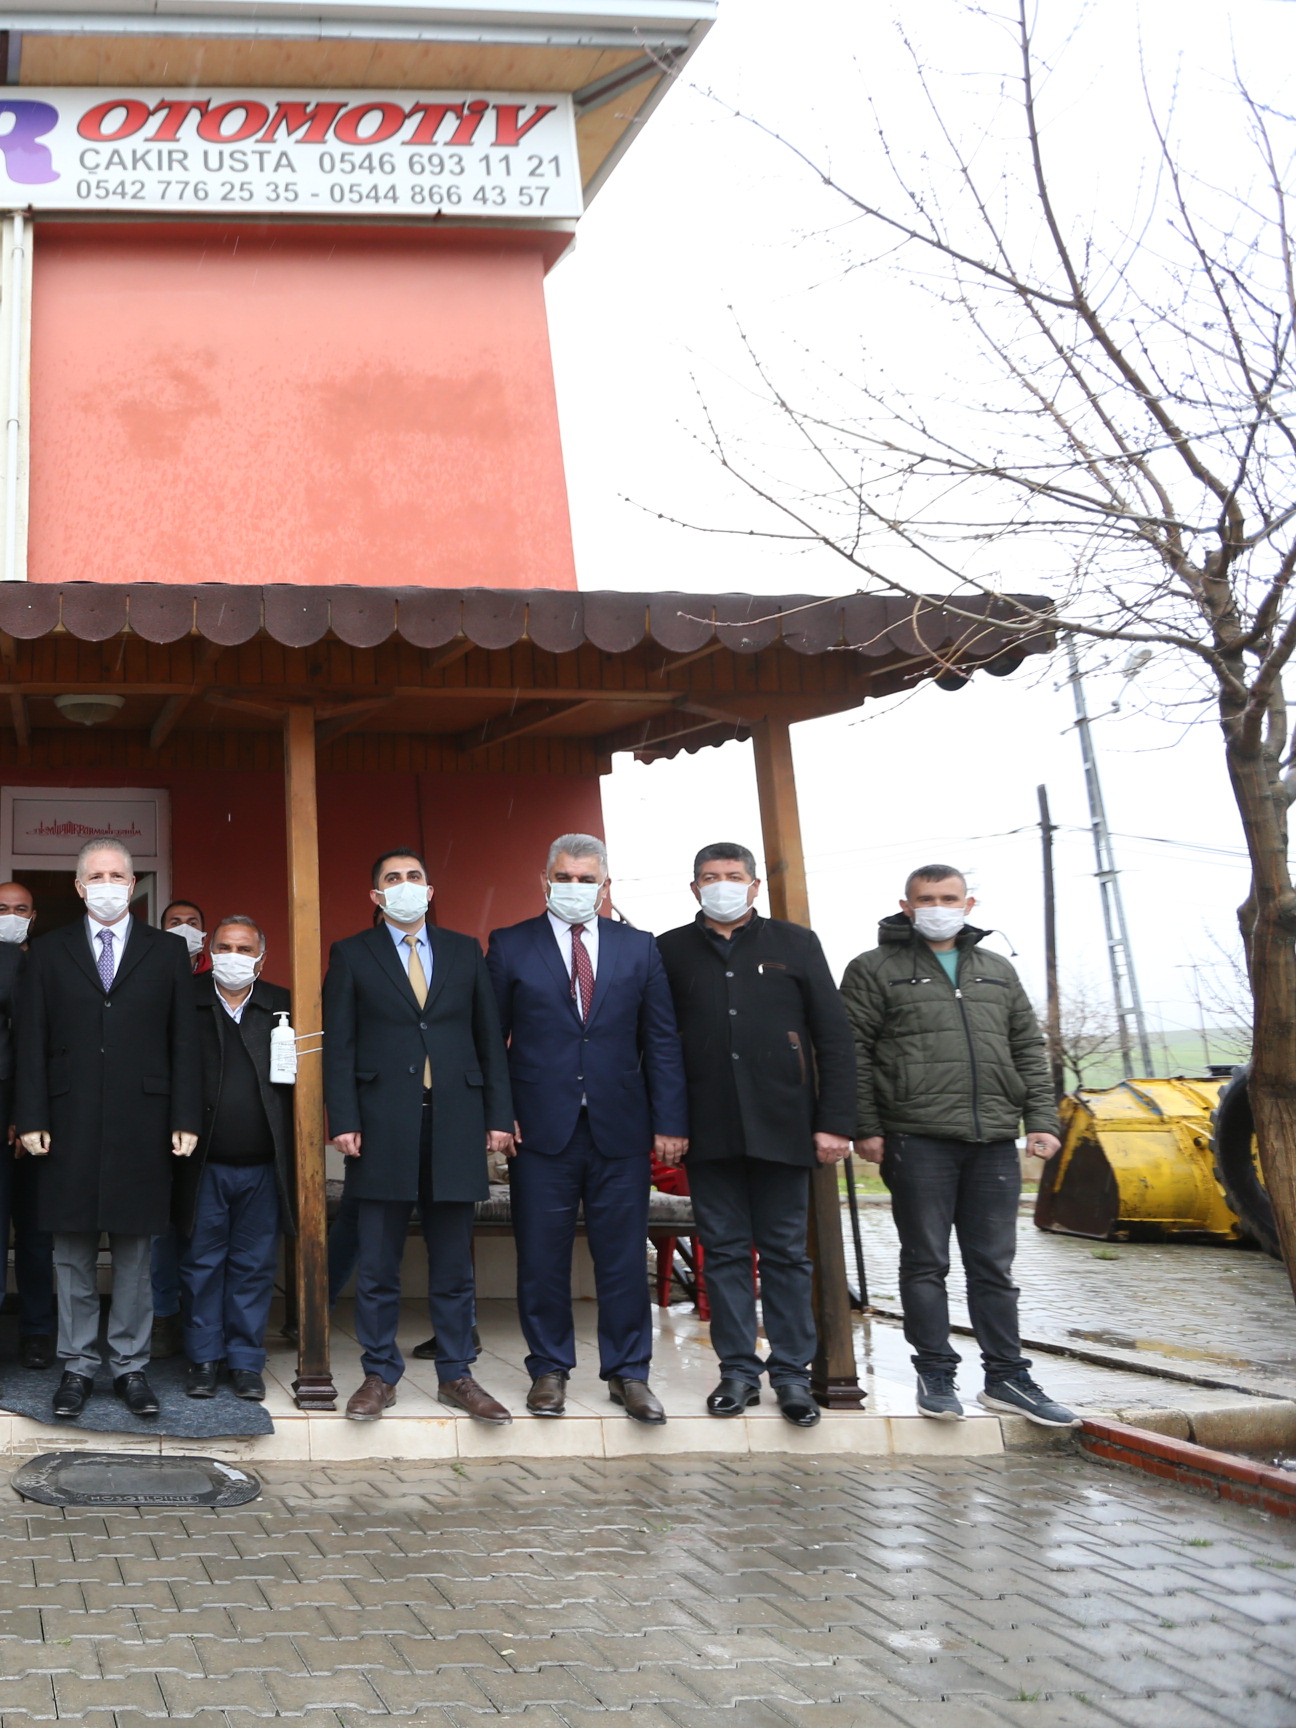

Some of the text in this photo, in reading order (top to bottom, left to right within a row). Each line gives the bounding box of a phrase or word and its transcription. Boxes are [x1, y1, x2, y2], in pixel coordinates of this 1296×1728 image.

[78, 148, 563, 178] ÇAKIR USTA 0546 693 11 21
[75, 178, 147, 201] 0542
[157, 178, 208, 202] 776
[220, 180, 254, 203] 25
[265, 180, 300, 203] 35
[329, 182, 400, 205] 0544
[410, 183, 462, 206] 866
[472, 184, 507, 207] 43
[517, 184, 551, 207] 57
